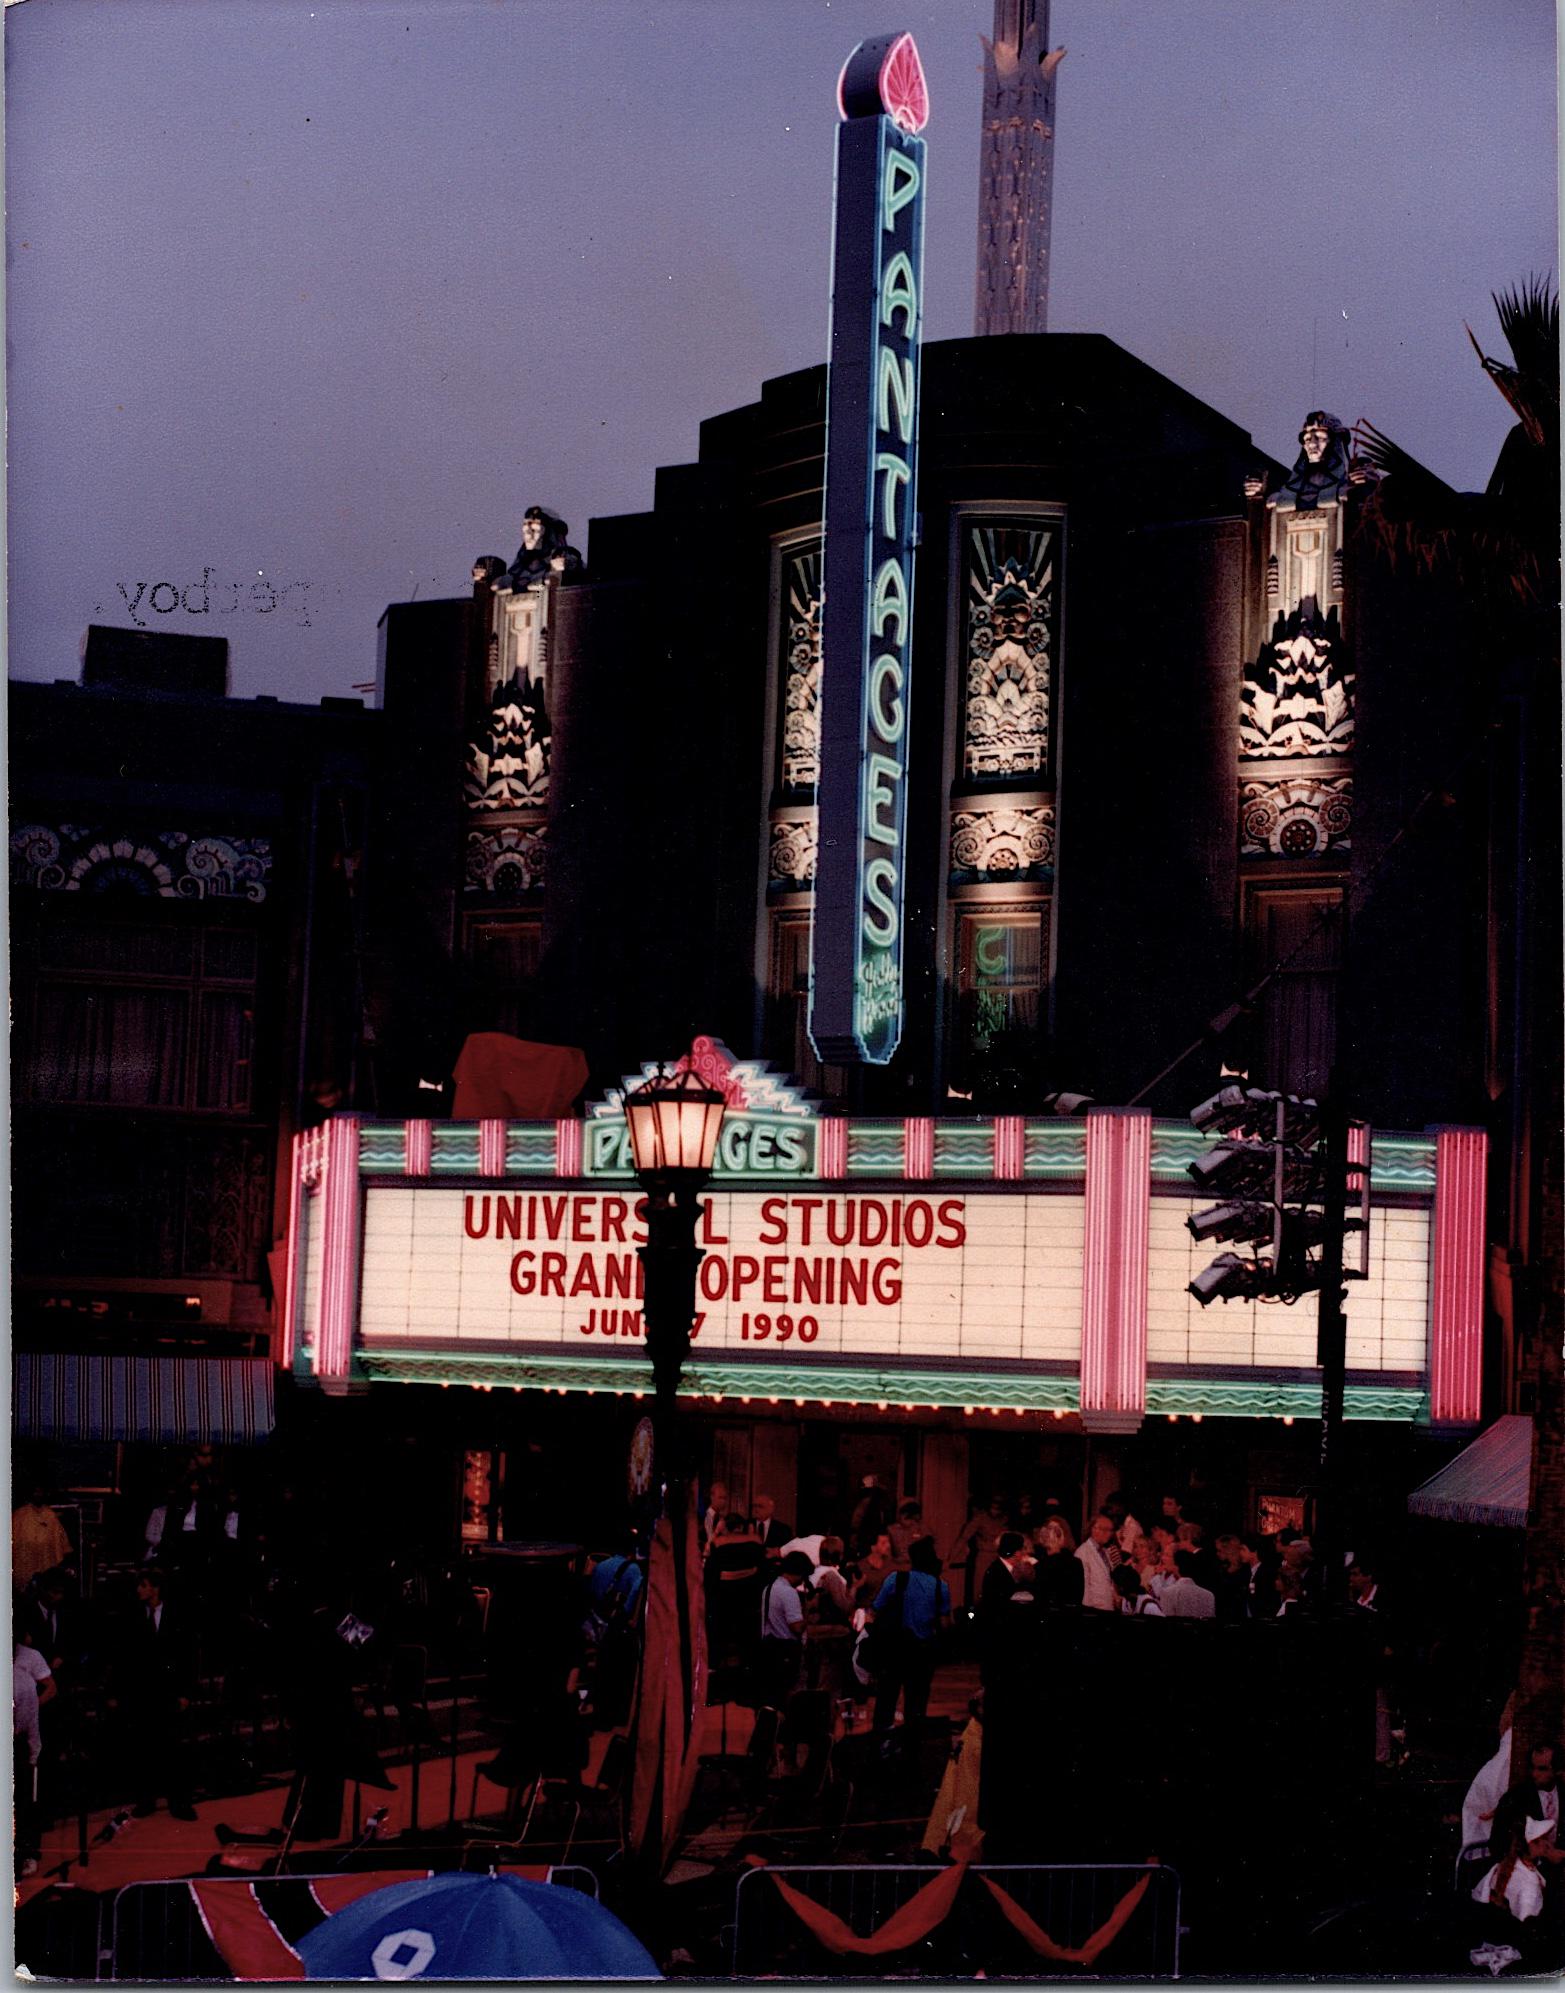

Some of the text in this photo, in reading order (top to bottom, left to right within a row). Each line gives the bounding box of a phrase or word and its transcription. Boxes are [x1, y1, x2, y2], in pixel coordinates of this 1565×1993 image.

[863, 146, 922, 949] PANTAGES
[464, 1195, 968, 1249] UNIVERSL STUDIOS
[510, 1249, 903, 1307] GRAN OPENING
[580, 1308, 650, 1338] JUN
[741, 1312, 820, 1344] 1990
